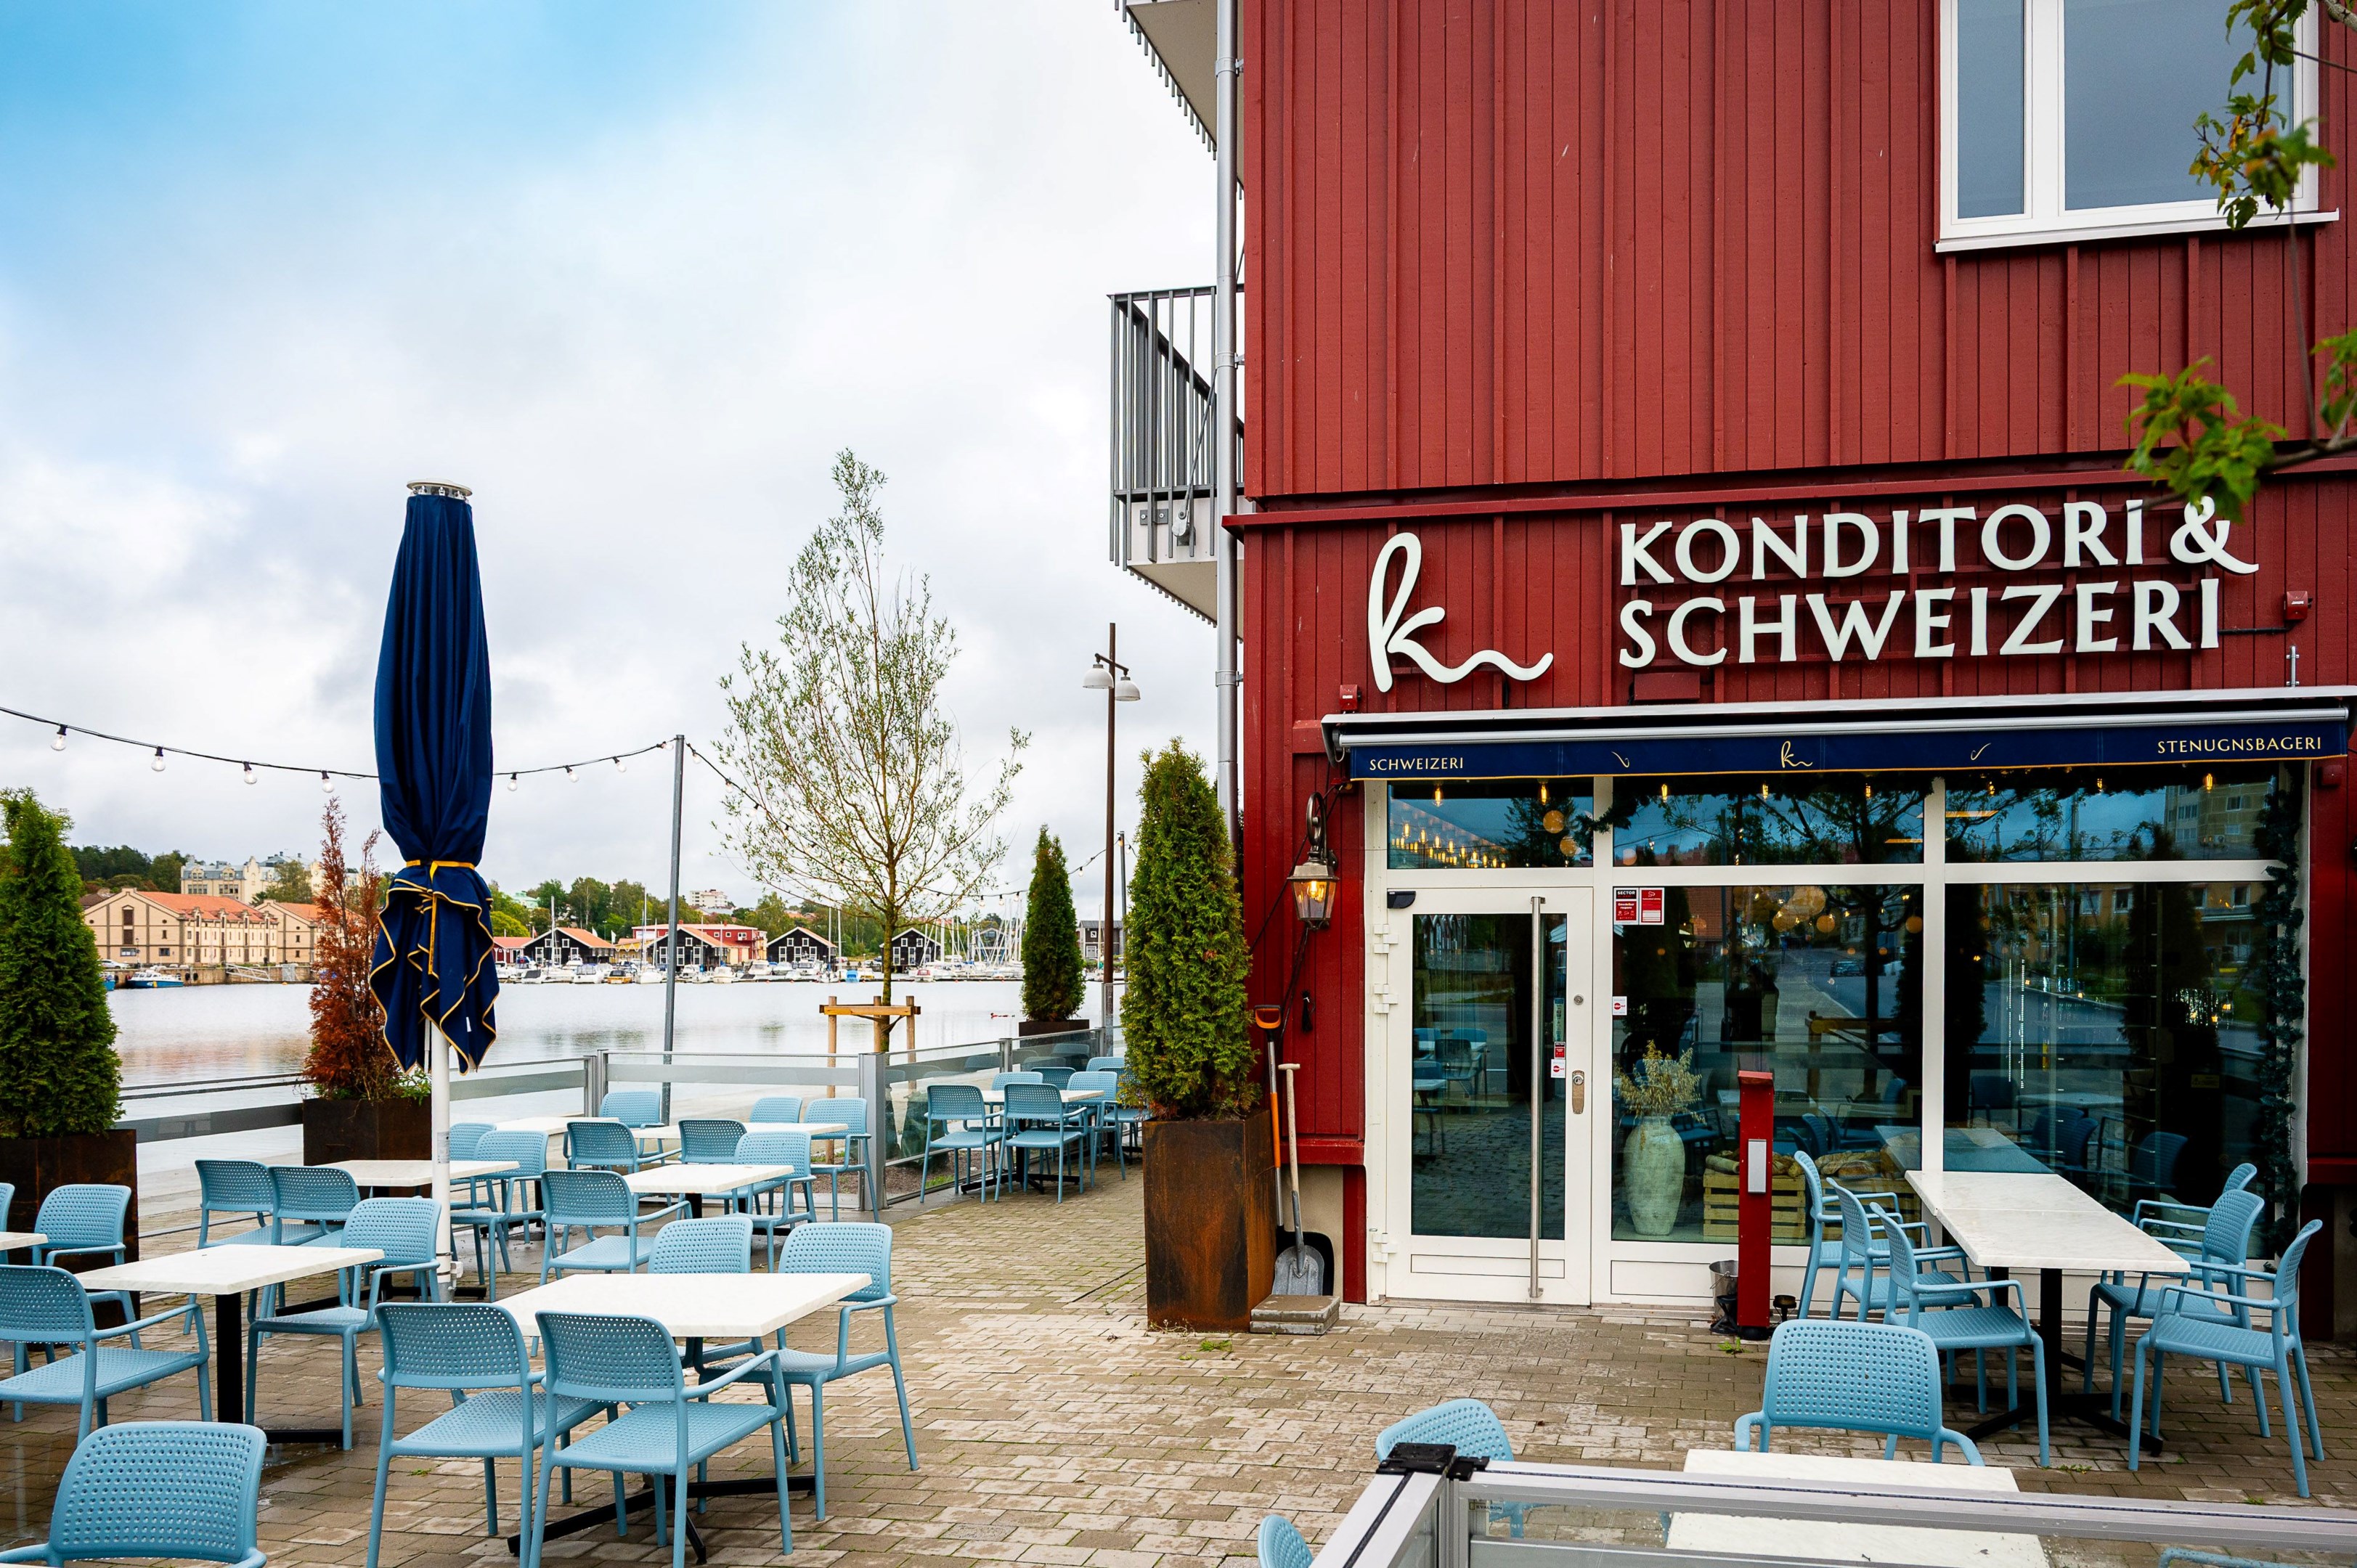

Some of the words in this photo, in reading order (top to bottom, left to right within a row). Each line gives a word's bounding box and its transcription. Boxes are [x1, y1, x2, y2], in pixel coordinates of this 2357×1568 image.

[1620, 499, 2144, 586] KONDITORI
[2170, 495, 2260, 575] &
[1619, 571, 2219, 669] SCHWEIZERI
[1369, 756, 1464, 771] SCHWEIZERI
[2157, 736, 2322, 754] STENUGNSBAGERI
